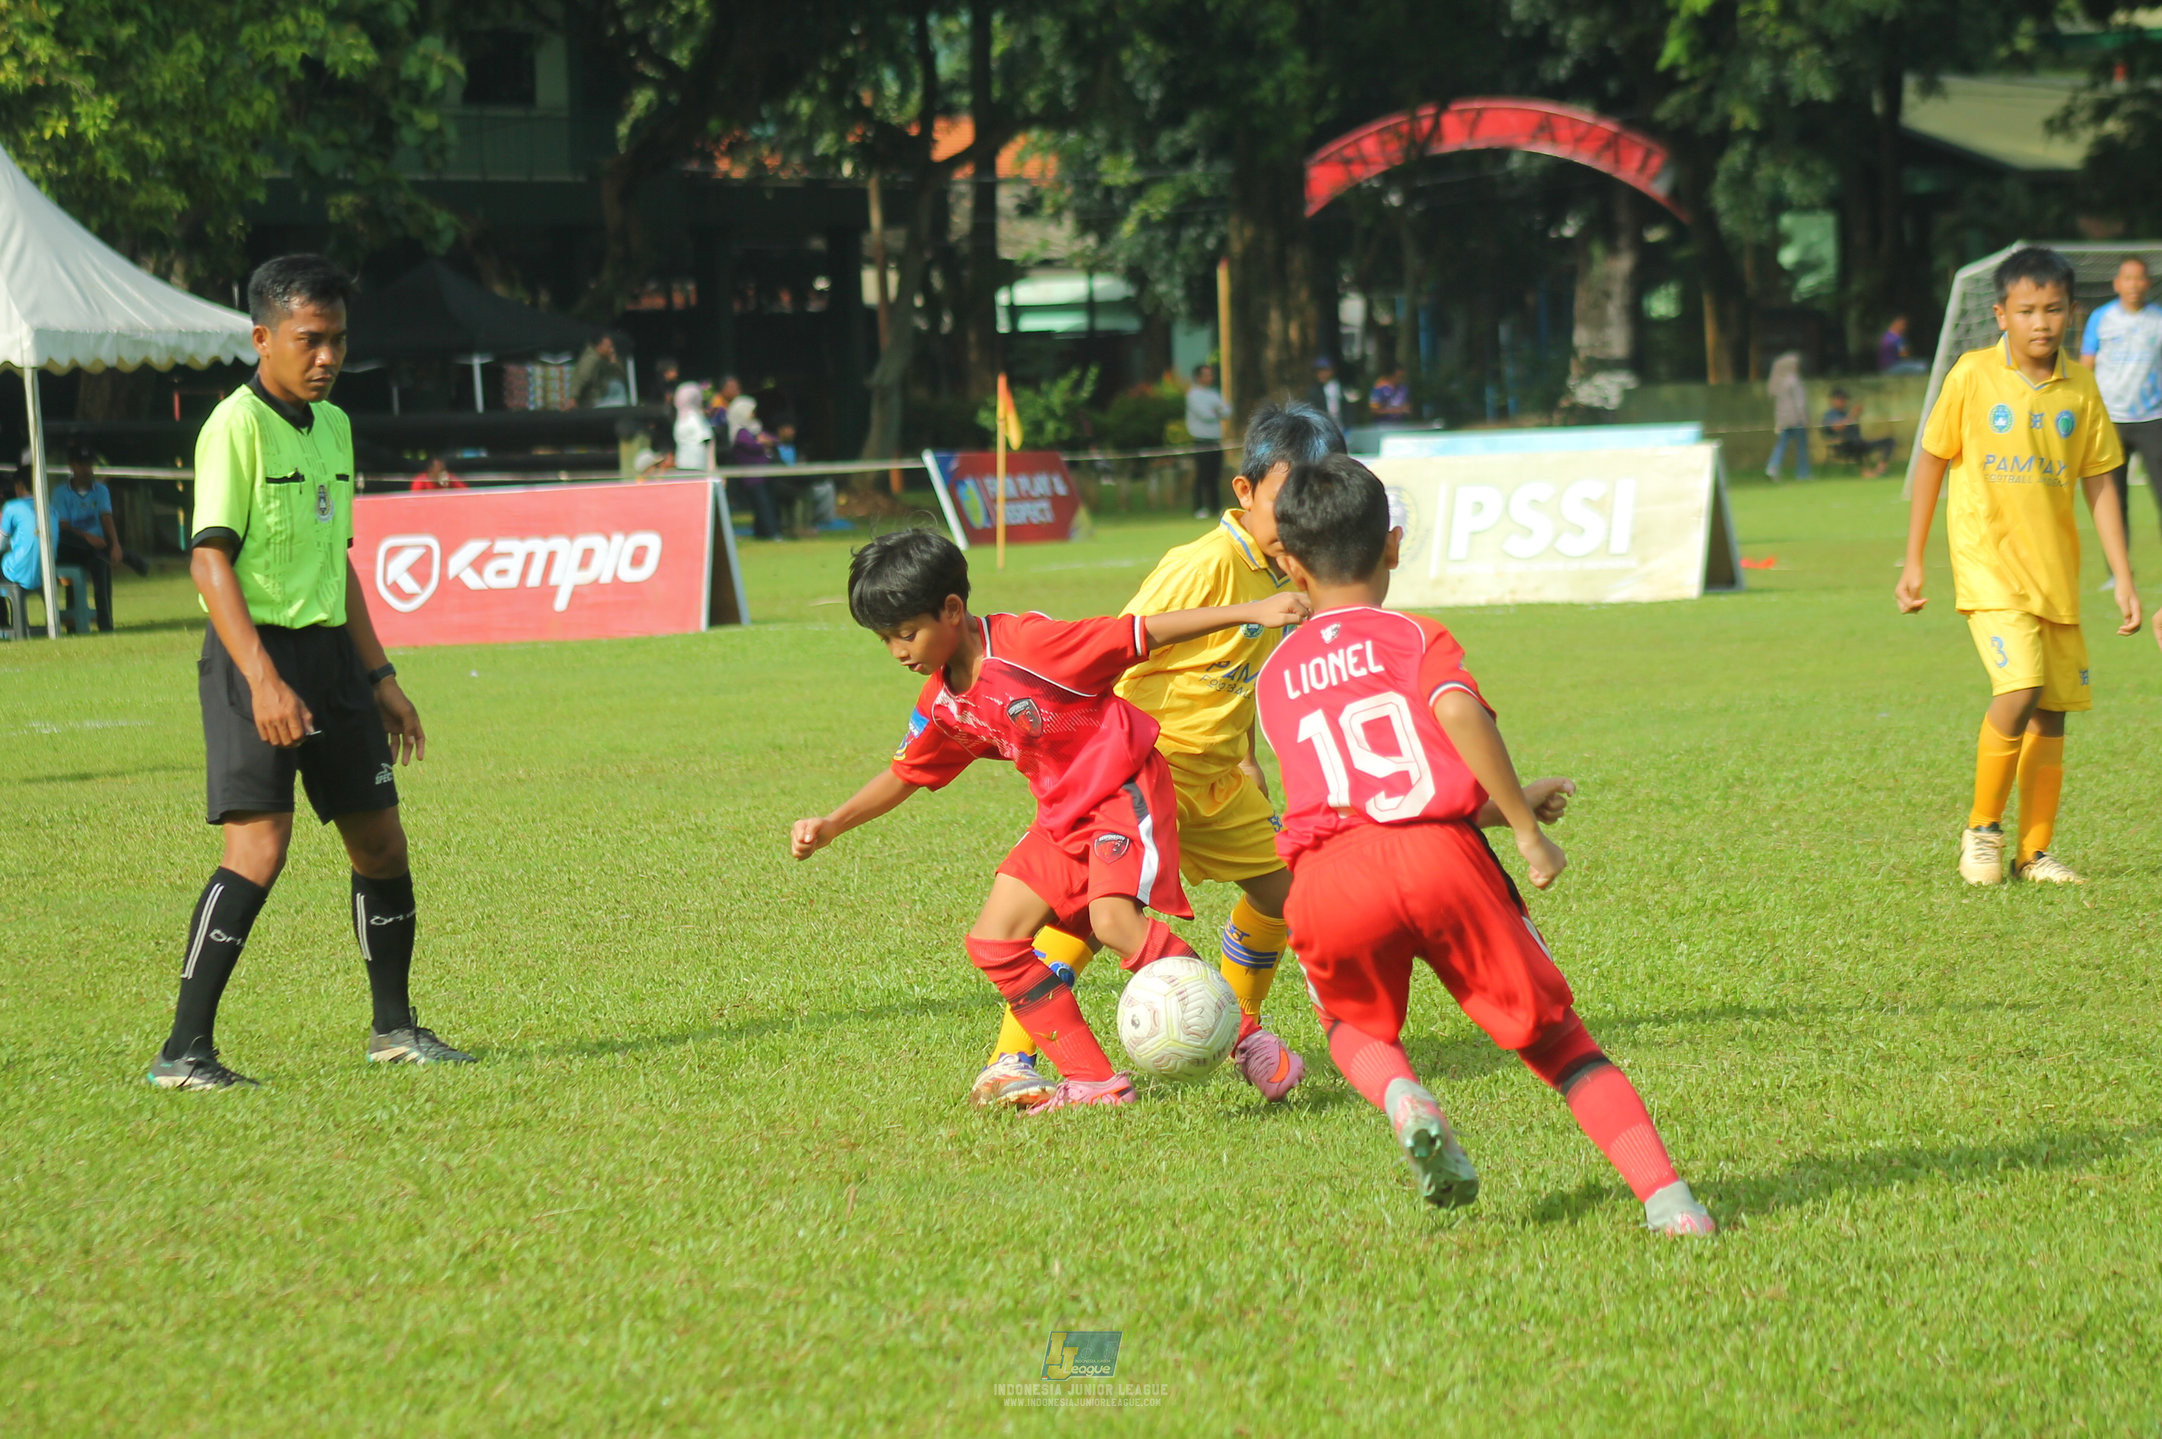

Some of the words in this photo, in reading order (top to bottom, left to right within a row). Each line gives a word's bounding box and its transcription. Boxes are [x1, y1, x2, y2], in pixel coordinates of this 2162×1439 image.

[1447, 477, 1637, 561] PSSI
[1283, 640, 1385, 700] LIONEL
[1991, 636, 2008, 669] 3
[1297, 691, 1436, 824] 19
